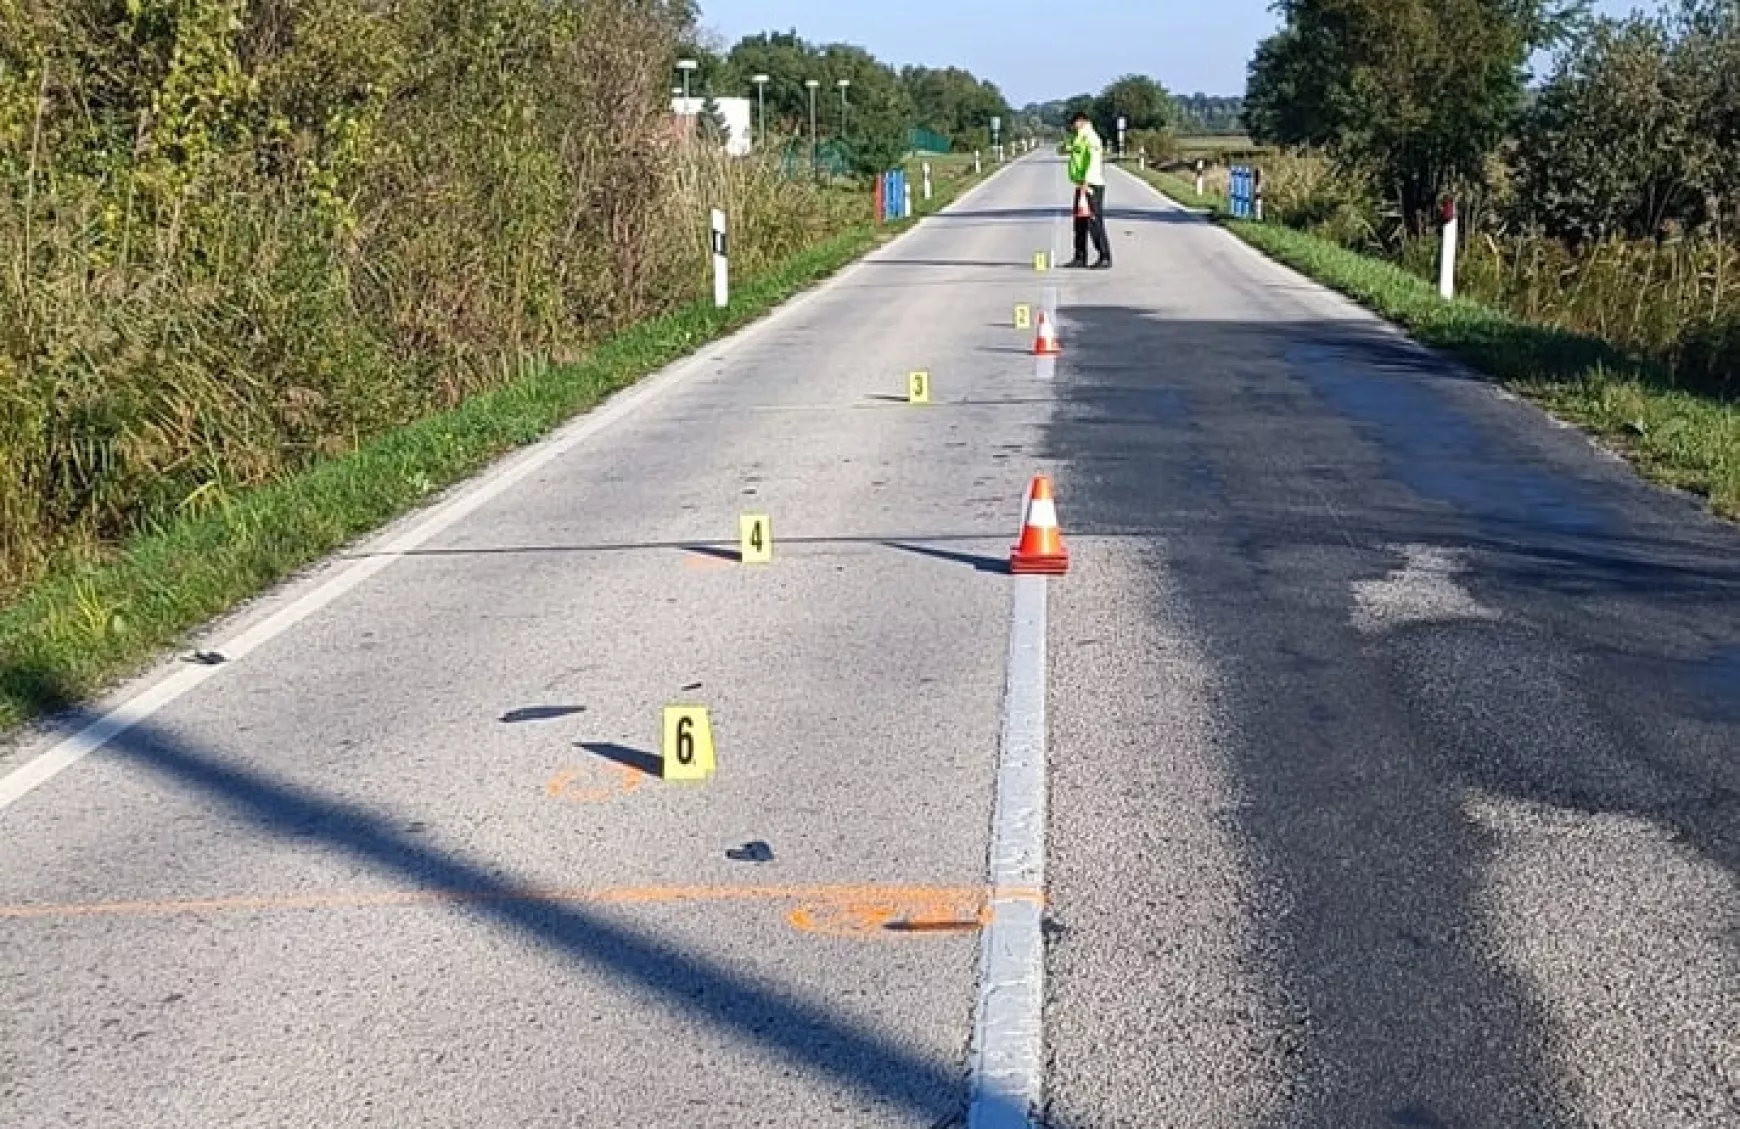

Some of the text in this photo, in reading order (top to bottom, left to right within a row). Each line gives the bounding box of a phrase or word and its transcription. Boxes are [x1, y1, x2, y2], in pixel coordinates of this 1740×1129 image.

[914, 374, 923, 397] 3
[750, 520, 763, 552] 4
[676, 715, 694, 765] 6
